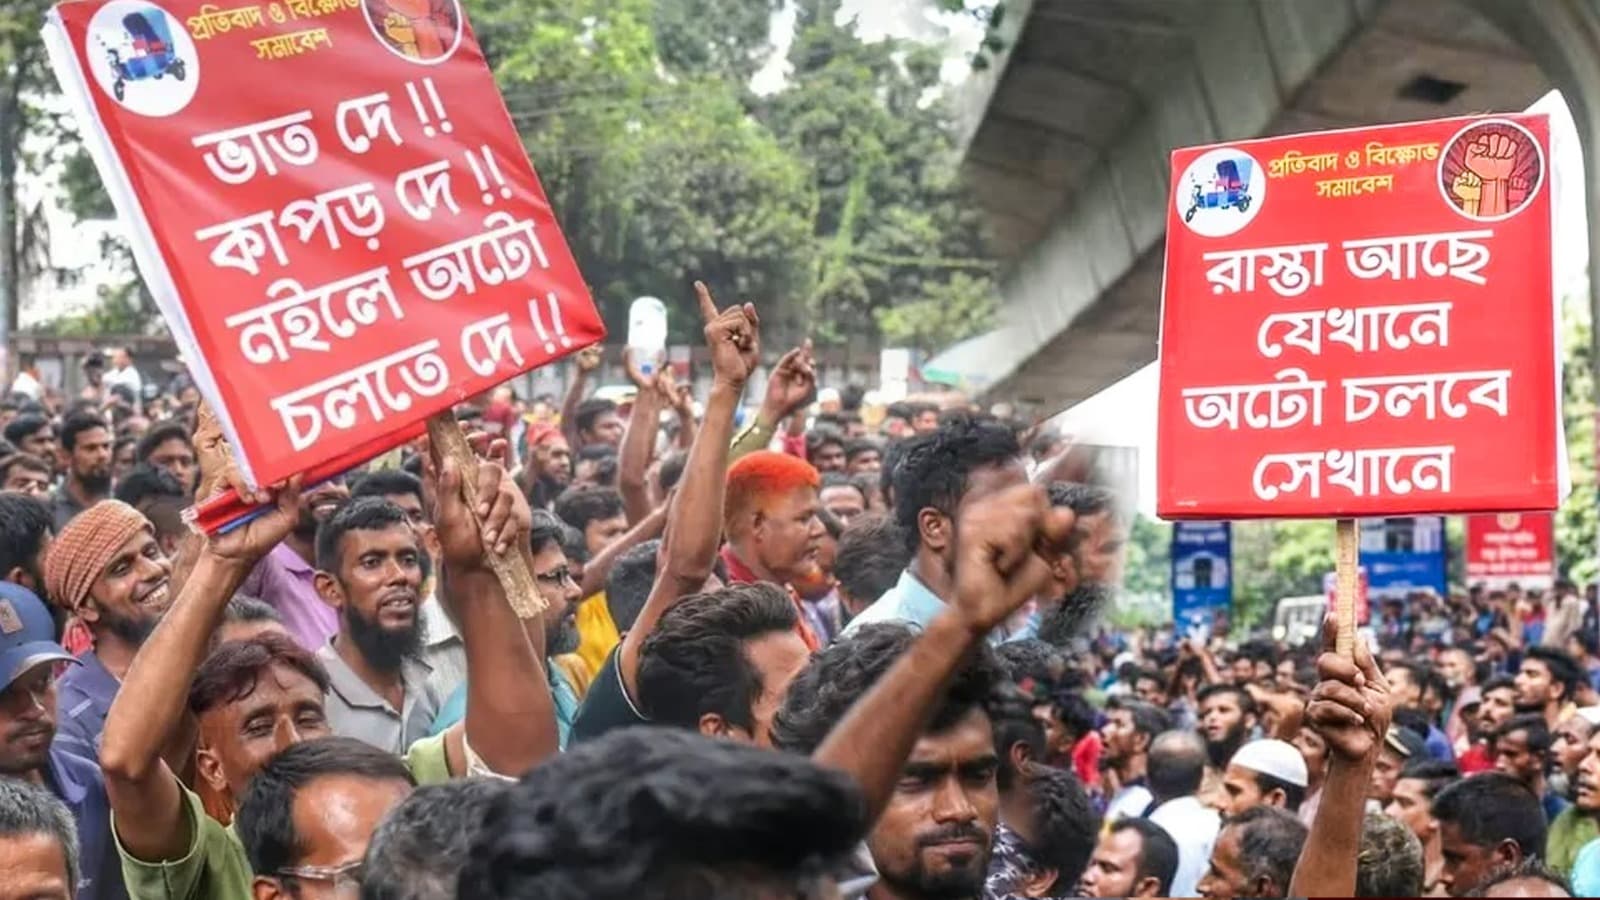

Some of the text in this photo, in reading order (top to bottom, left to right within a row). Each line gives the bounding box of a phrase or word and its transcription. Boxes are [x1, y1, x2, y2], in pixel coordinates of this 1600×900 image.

[187, 4, 266, 40] প্রতিবাদ
[268, 2, 287, 24] ও
[250, 28, 334, 60] সমাবেশ
[192, 77, 453, 184] ভাত দে !!
[1268, 141, 1441, 179] প্রতিবাদ ও বিক্ষোভ
[195, 145, 512, 276] কাপড় দে !!
[1315, 174, 1394, 198] সমাবেশ
[225, 211, 550, 364] নইলে অটো
[1203, 229, 1494, 297] রাস্তা আছে
[1257, 301, 1453, 359] যেখানে
[270, 292, 573, 452] চলতে দে !!
[1181, 367, 1512, 430] অটো চলবে
[1252, 445, 1456, 501] সেখানে
